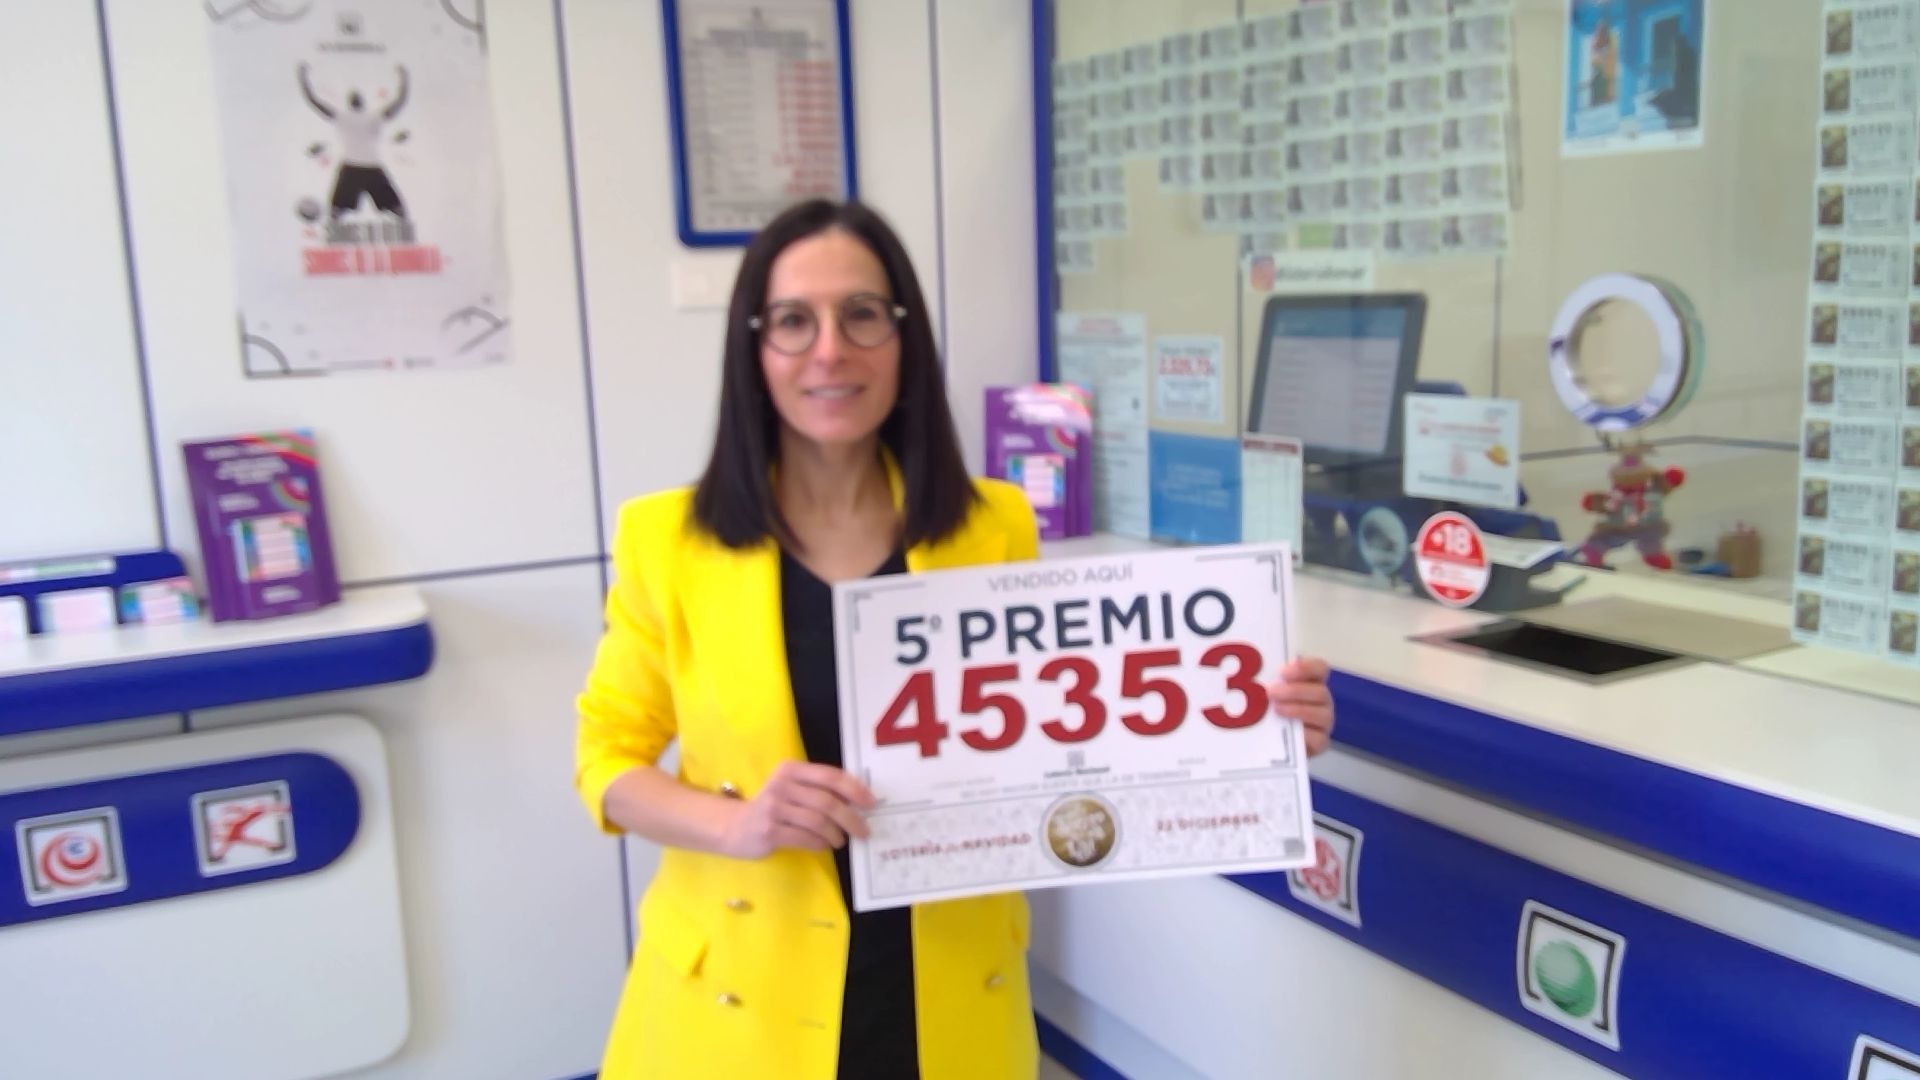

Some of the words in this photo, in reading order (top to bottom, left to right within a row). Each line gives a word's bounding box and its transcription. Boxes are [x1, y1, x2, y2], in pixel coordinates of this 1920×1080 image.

[1431, 524, 1471, 556] +18
[987, 568, 1078, 592] VENDIDO
[1083, 562, 1134, 584] AQUÍ
[959, 588, 1236, 659] PREMIO
[874, 642, 1270, 759] 45353
